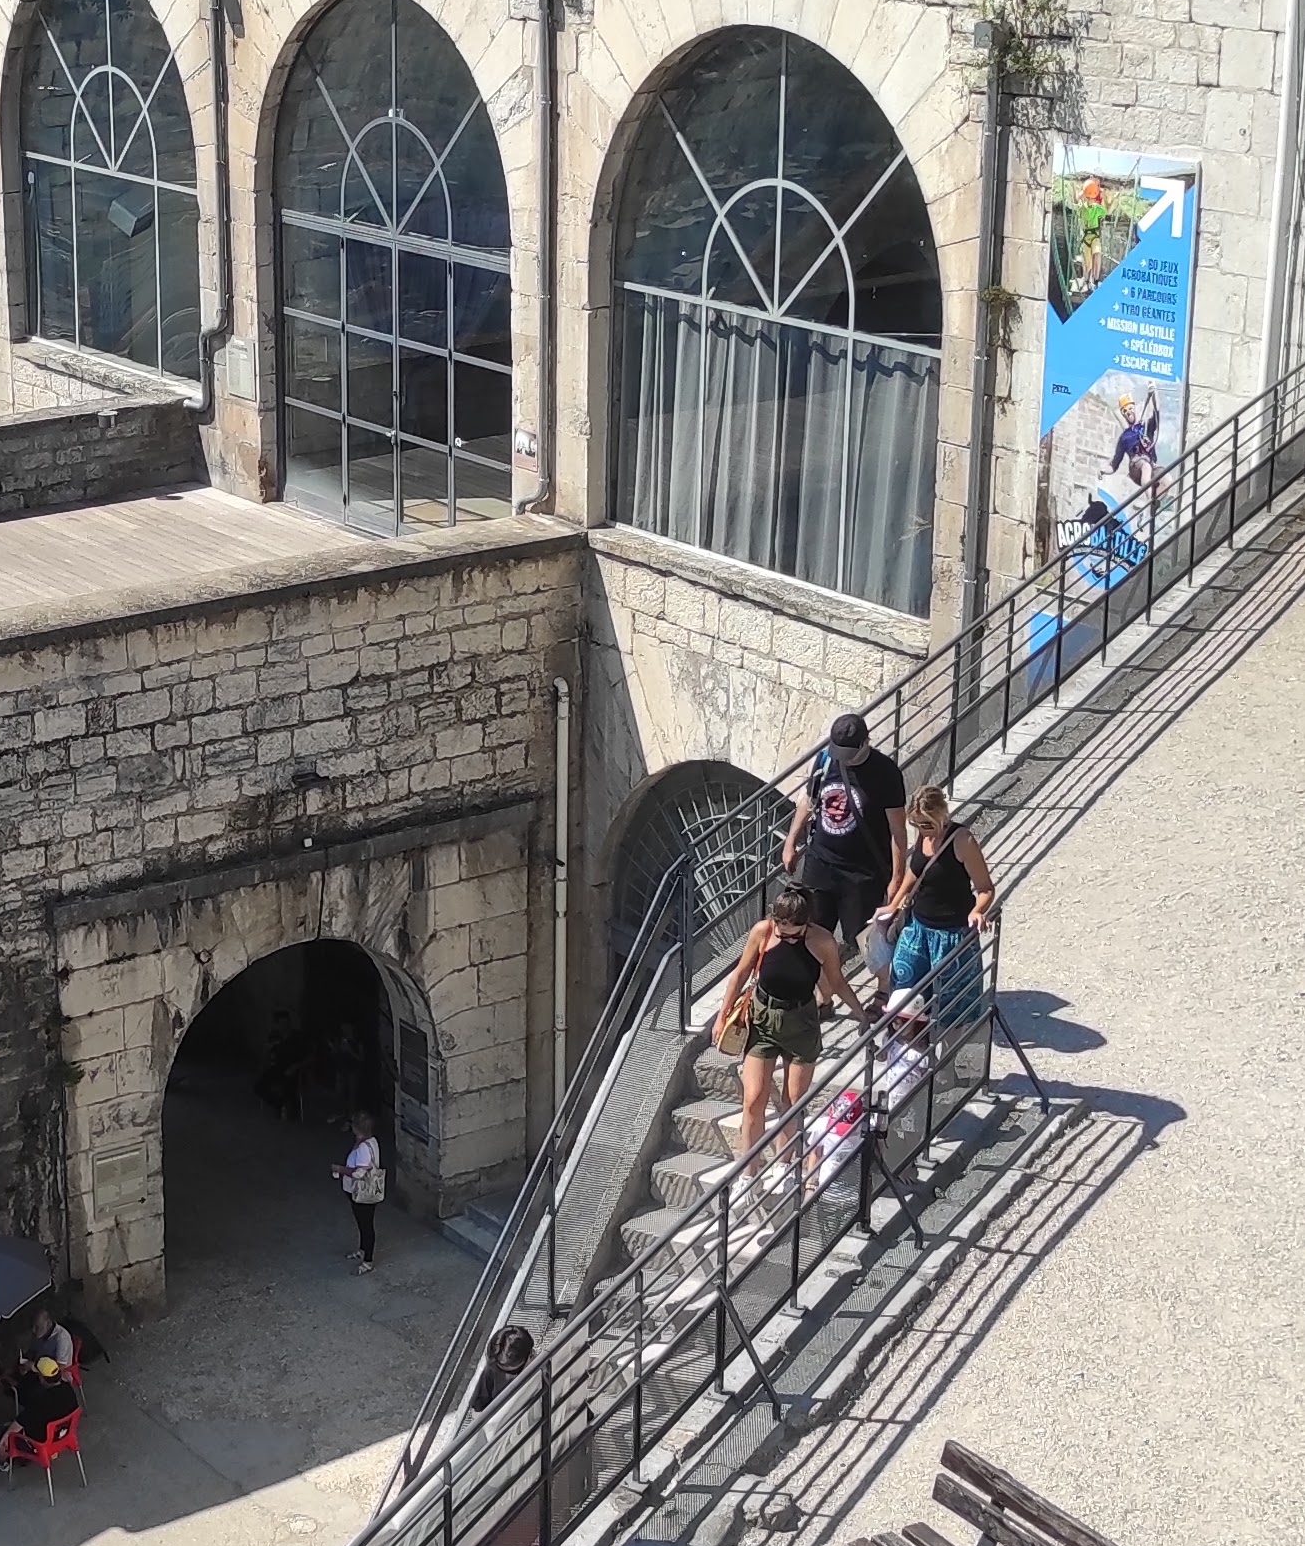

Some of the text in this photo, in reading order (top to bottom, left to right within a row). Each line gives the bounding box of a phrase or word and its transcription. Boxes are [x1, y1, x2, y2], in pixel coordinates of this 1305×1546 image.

[1160, 261, 1179, 274] JEUX
[1121, 268, 1178, 287] ACROBATIQUES
[1137, 287, 1177, 305] PARCOURS
[1107, 317, 1175, 342] MISSION BASTILLE
[1151, 361, 1173, 376] GAME
